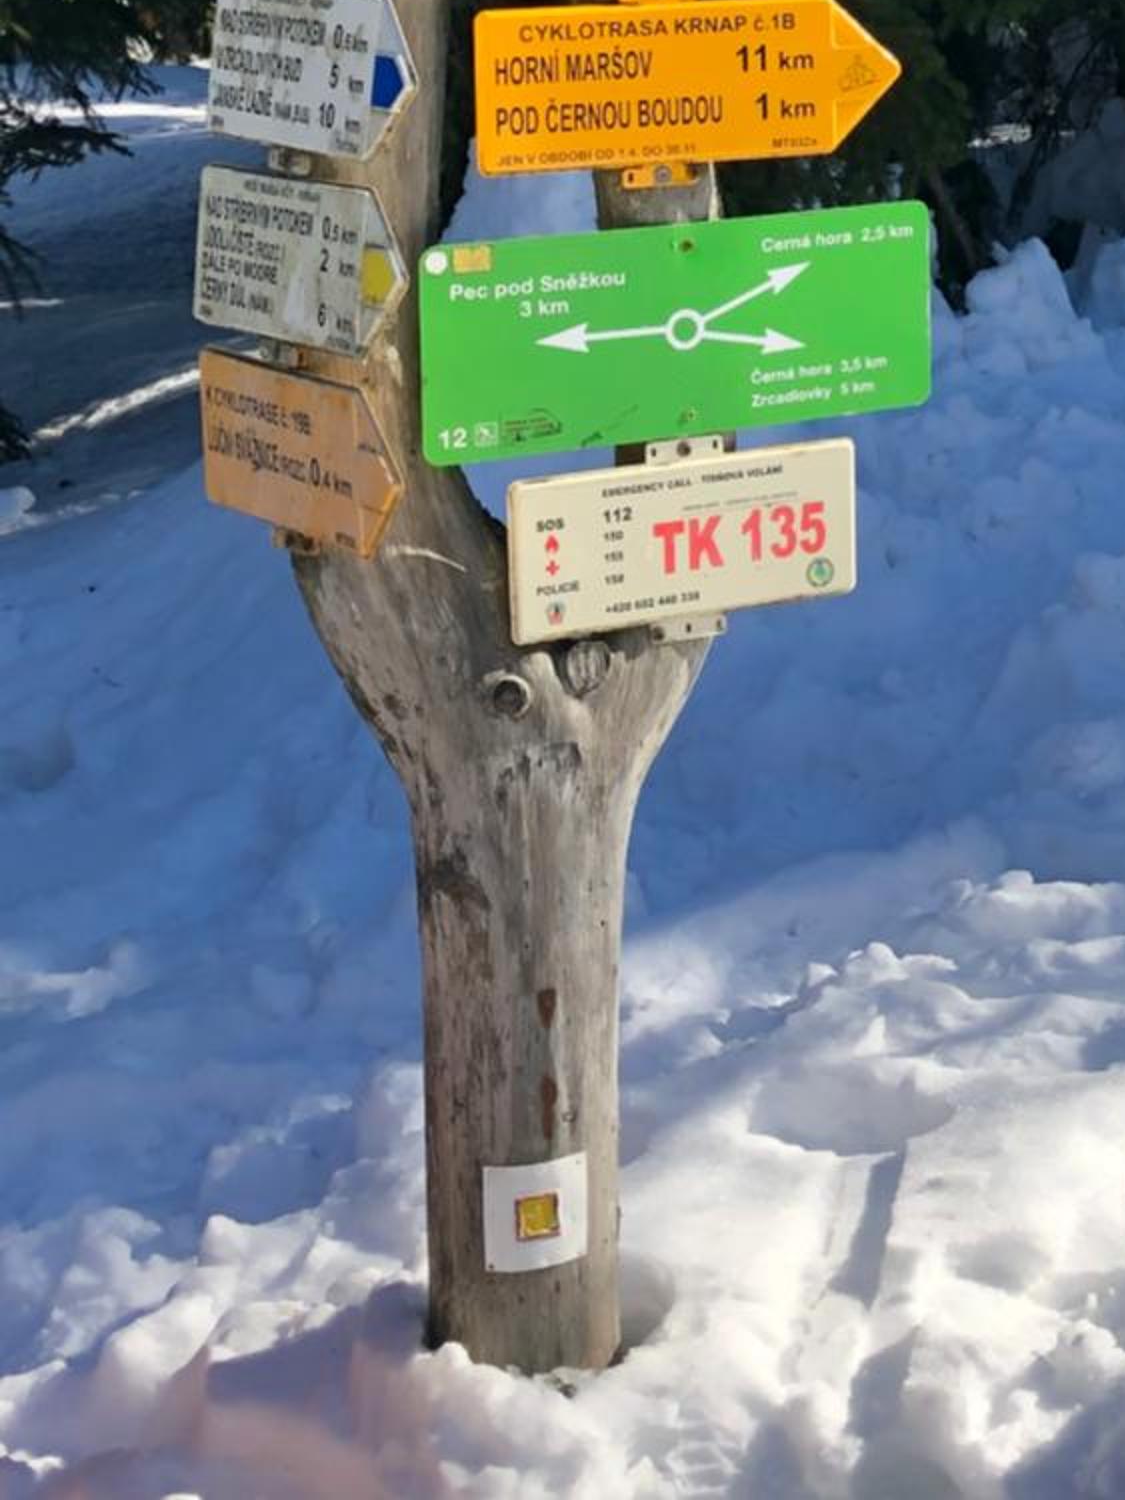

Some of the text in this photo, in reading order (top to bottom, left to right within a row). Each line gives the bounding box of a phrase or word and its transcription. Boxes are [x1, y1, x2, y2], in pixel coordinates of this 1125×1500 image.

[518, 19, 668, 43] CYKLOTRASA
[674, 15, 747, 36] KRNAP
[771, 13, 796, 32] 1B
[495, 45, 815, 86] HORNÍ MARŠOV 11 km
[329, 63, 340, 89] 5
[348, 75, 365, 95] km
[319, 102, 337, 130] 10
[345, 115, 361, 133] km
[495, 94, 816, 137] POD ČERNOU BOUDOU 1 km
[595, 148, 614, 161] OD
[341, 228, 359, 245] km
[815, 231, 852, 247] hora
[861, 225, 886, 243] 2,5
[888, 223, 914, 239] km
[320, 248, 355, 277] 2 km
[449, 270, 627, 302] Pec pod Sněžkou
[317, 302, 327, 328] 6
[518, 299, 569, 318] 3 km
[799, 363, 832, 378] hora
[865, 355, 888, 370] km
[840, 381, 850, 396] 5
[853, 380, 876, 394] km
[438, 427, 468, 449] 12
[333, 476, 353, 498] km
[602, 481, 664, 498] EMERGENCY
[667, 477, 692, 491] CALL
[536, 518, 565, 533] SOS
[603, 507, 633, 524] 112
[652, 501, 827, 576] TK 135
[536, 579, 581, 597] POLICIE
